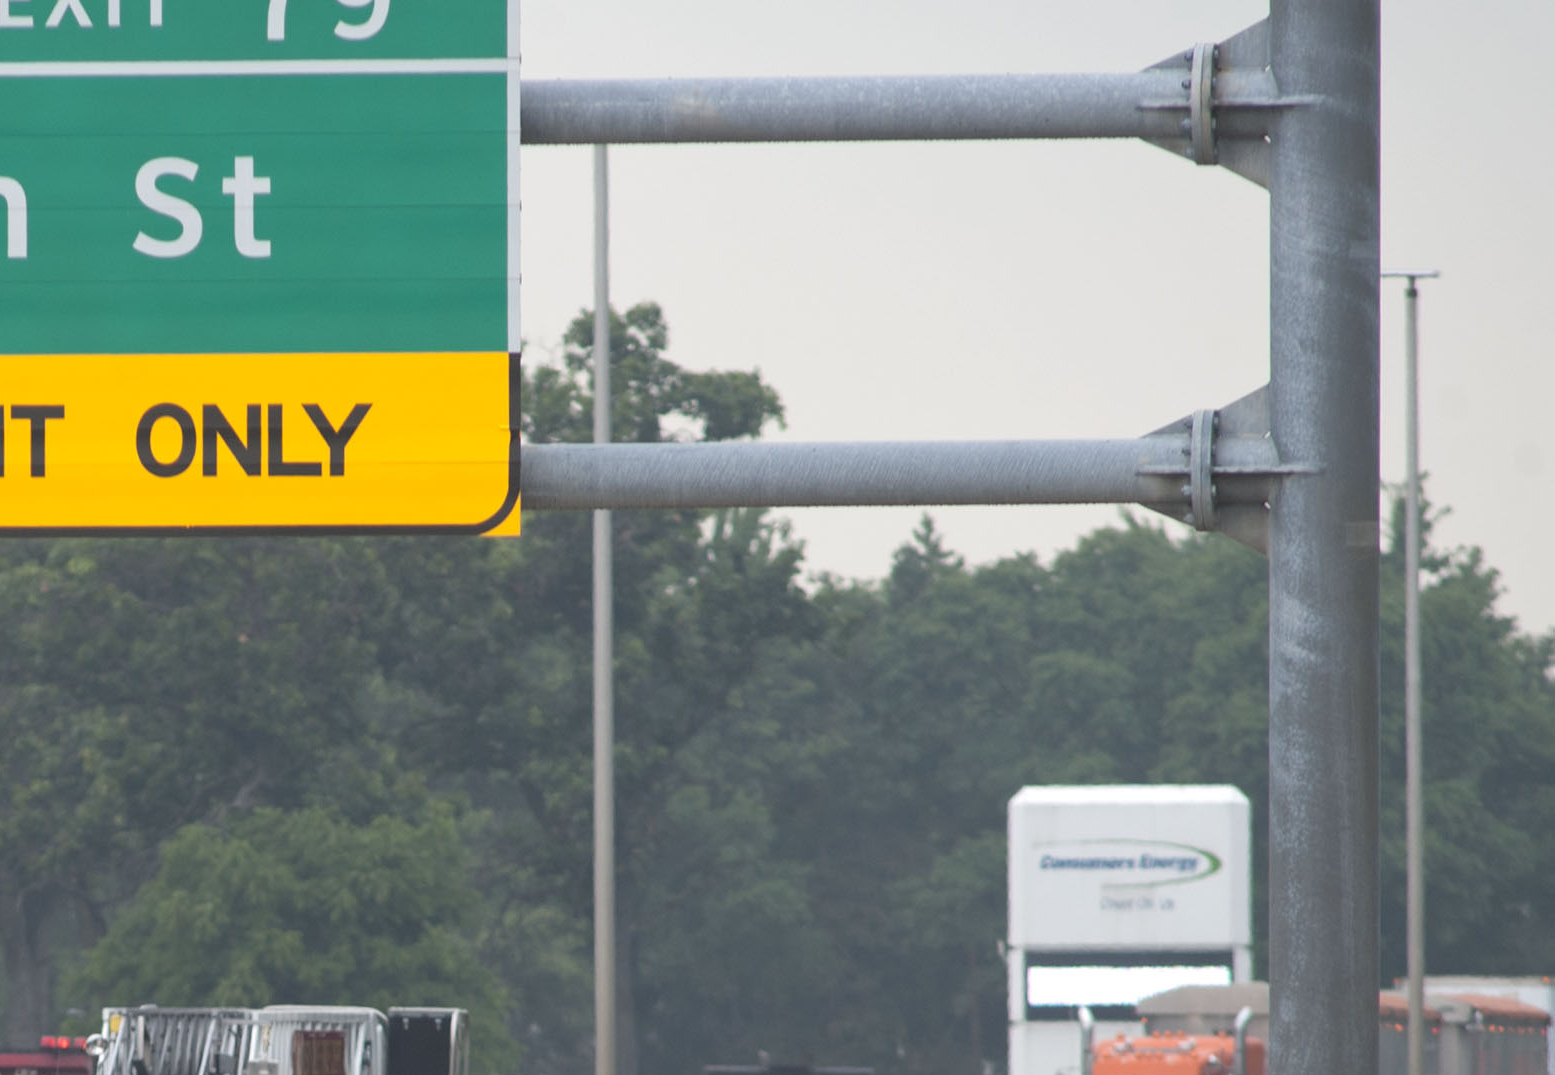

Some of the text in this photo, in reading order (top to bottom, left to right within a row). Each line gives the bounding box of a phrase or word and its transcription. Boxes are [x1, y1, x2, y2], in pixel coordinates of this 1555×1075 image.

[131, 155, 273, 259] St
[135, 402, 373, 479] ONLY
[1039, 853, 1198, 872] Consumers Energy
